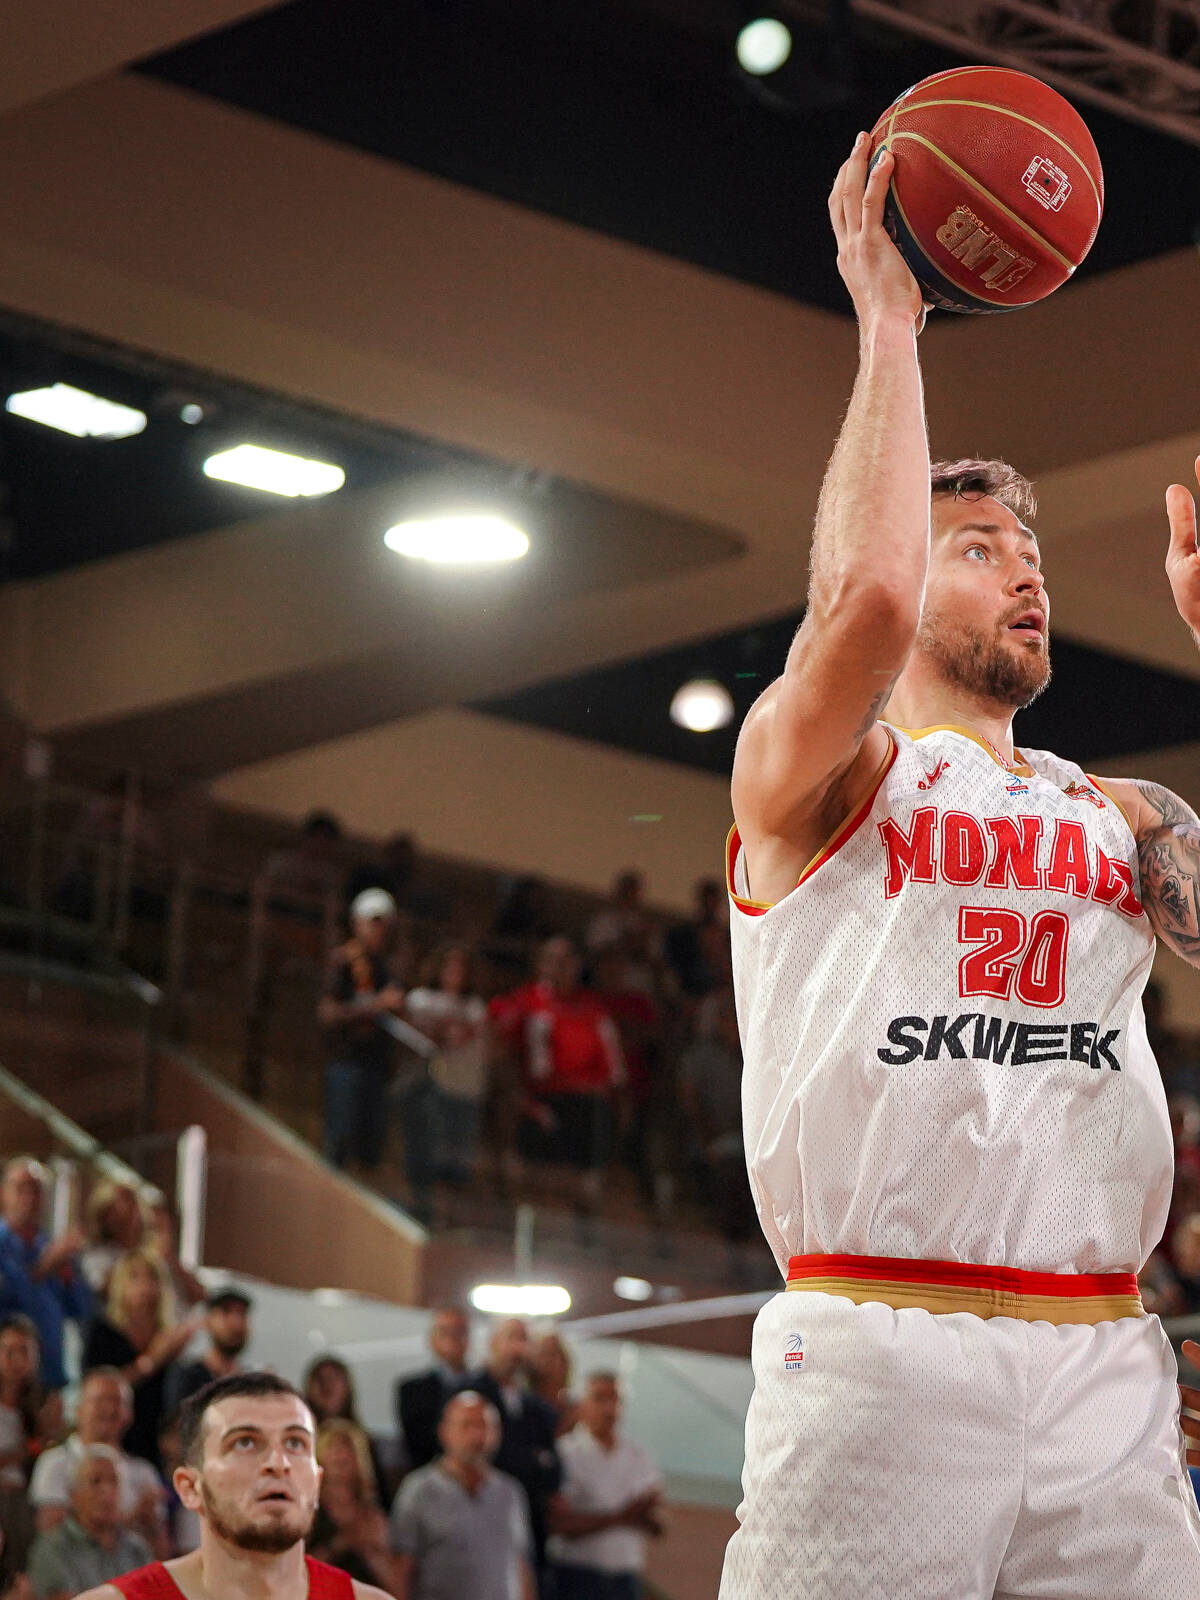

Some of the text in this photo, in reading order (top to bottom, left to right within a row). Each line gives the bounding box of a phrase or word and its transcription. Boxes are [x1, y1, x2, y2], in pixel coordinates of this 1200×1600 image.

[936, 211, 1017, 282] LNB
[957, 905, 1069, 1009] 20
[877, 1013, 1121, 1072] SKWEEK
